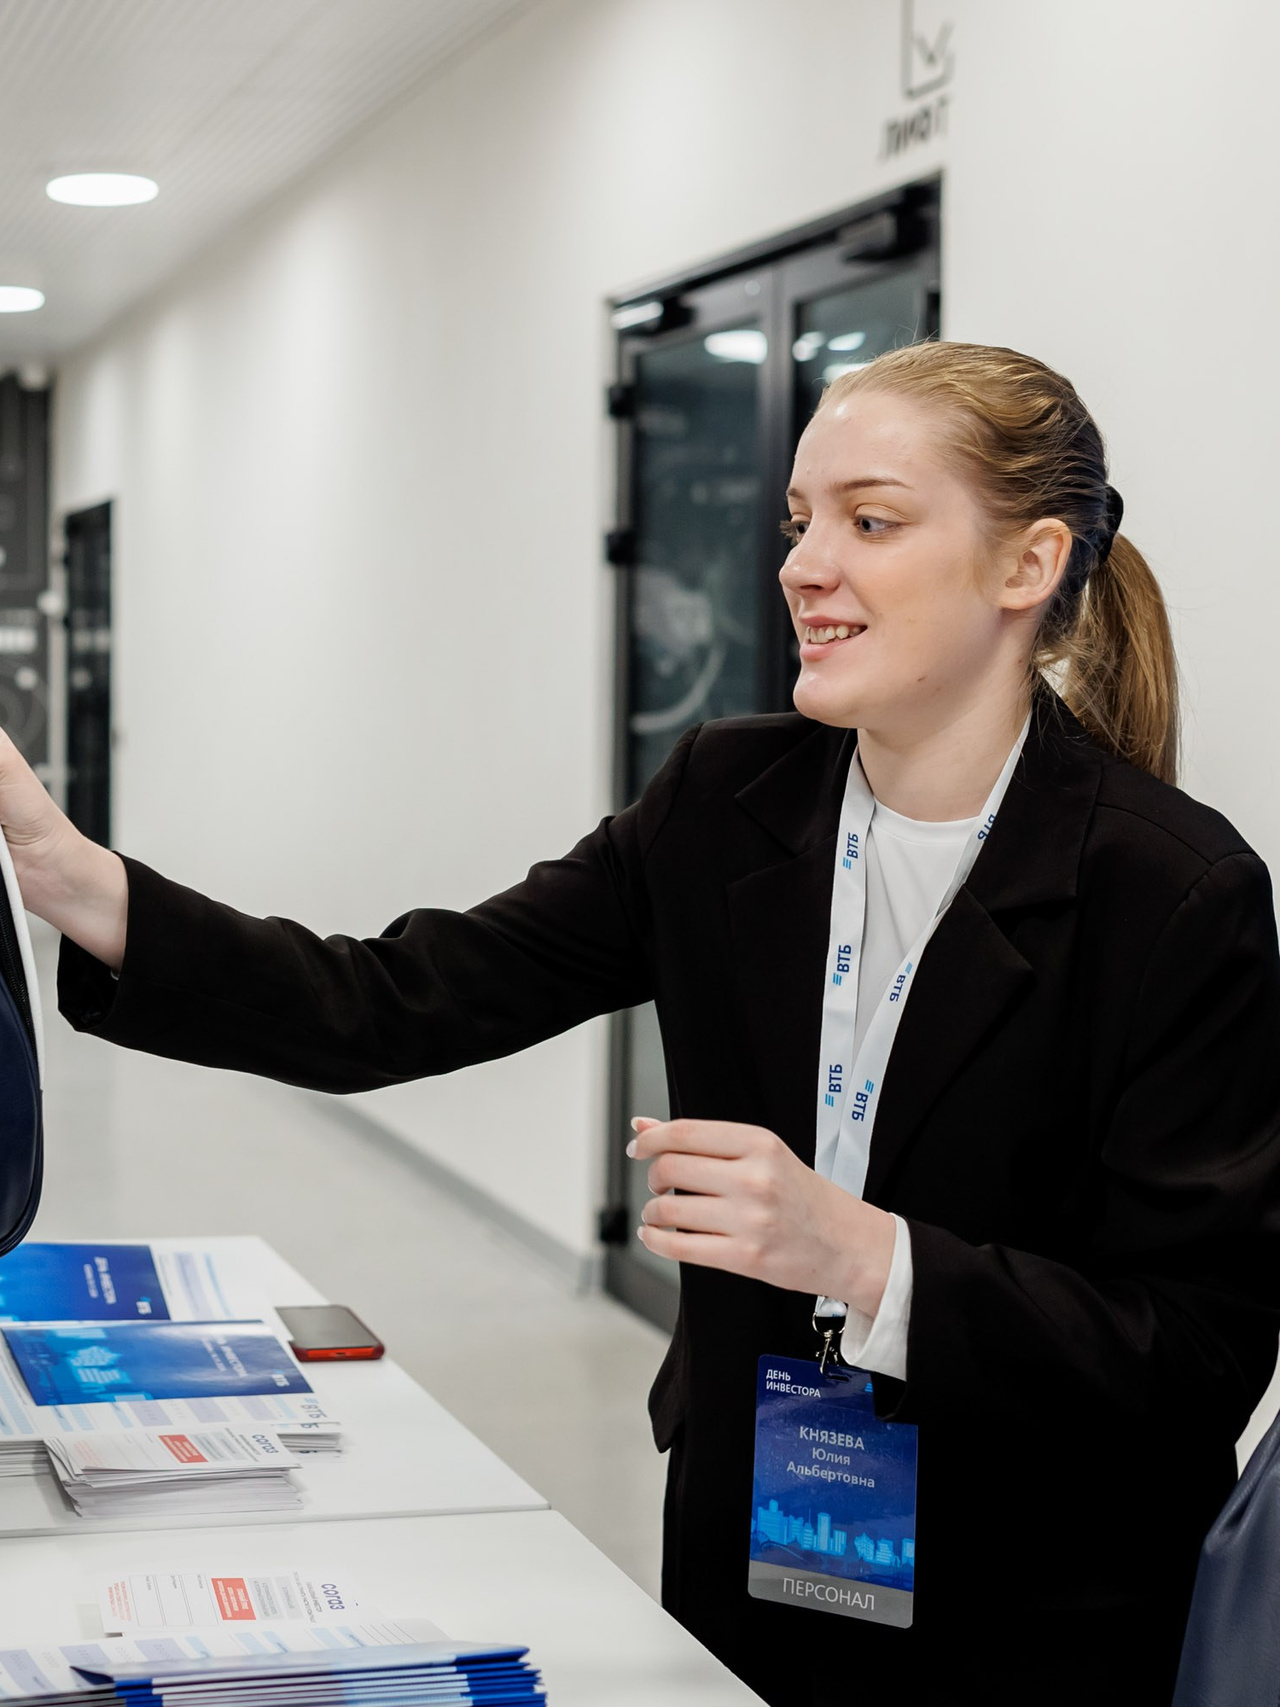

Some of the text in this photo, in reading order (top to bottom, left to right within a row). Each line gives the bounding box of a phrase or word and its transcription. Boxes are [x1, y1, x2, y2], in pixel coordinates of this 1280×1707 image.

[846, 832, 859, 859] ВТБ
[837, 945, 851, 973] ВТБ
[889, 974, 906, 1002] ВТБ
[829, 1064, 842, 1093] ВТБ
[851, 1091, 868, 1121] ВТБ
[766, 1369, 791, 1381] ДЕНЬ
[766, 1381, 821, 1398] ИНВЕСТОРА
[300, 1404, 327, 1419] ВТБ
[799, 1426, 865, 1450] КНЯЗЕВА
[812, 1447, 851, 1465] Юлия
[787, 1461, 875, 1488] Альбертовна
[321, 1583, 346, 1610] согаз
[783, 1578, 875, 1610] ПЕРСОНАЛ
